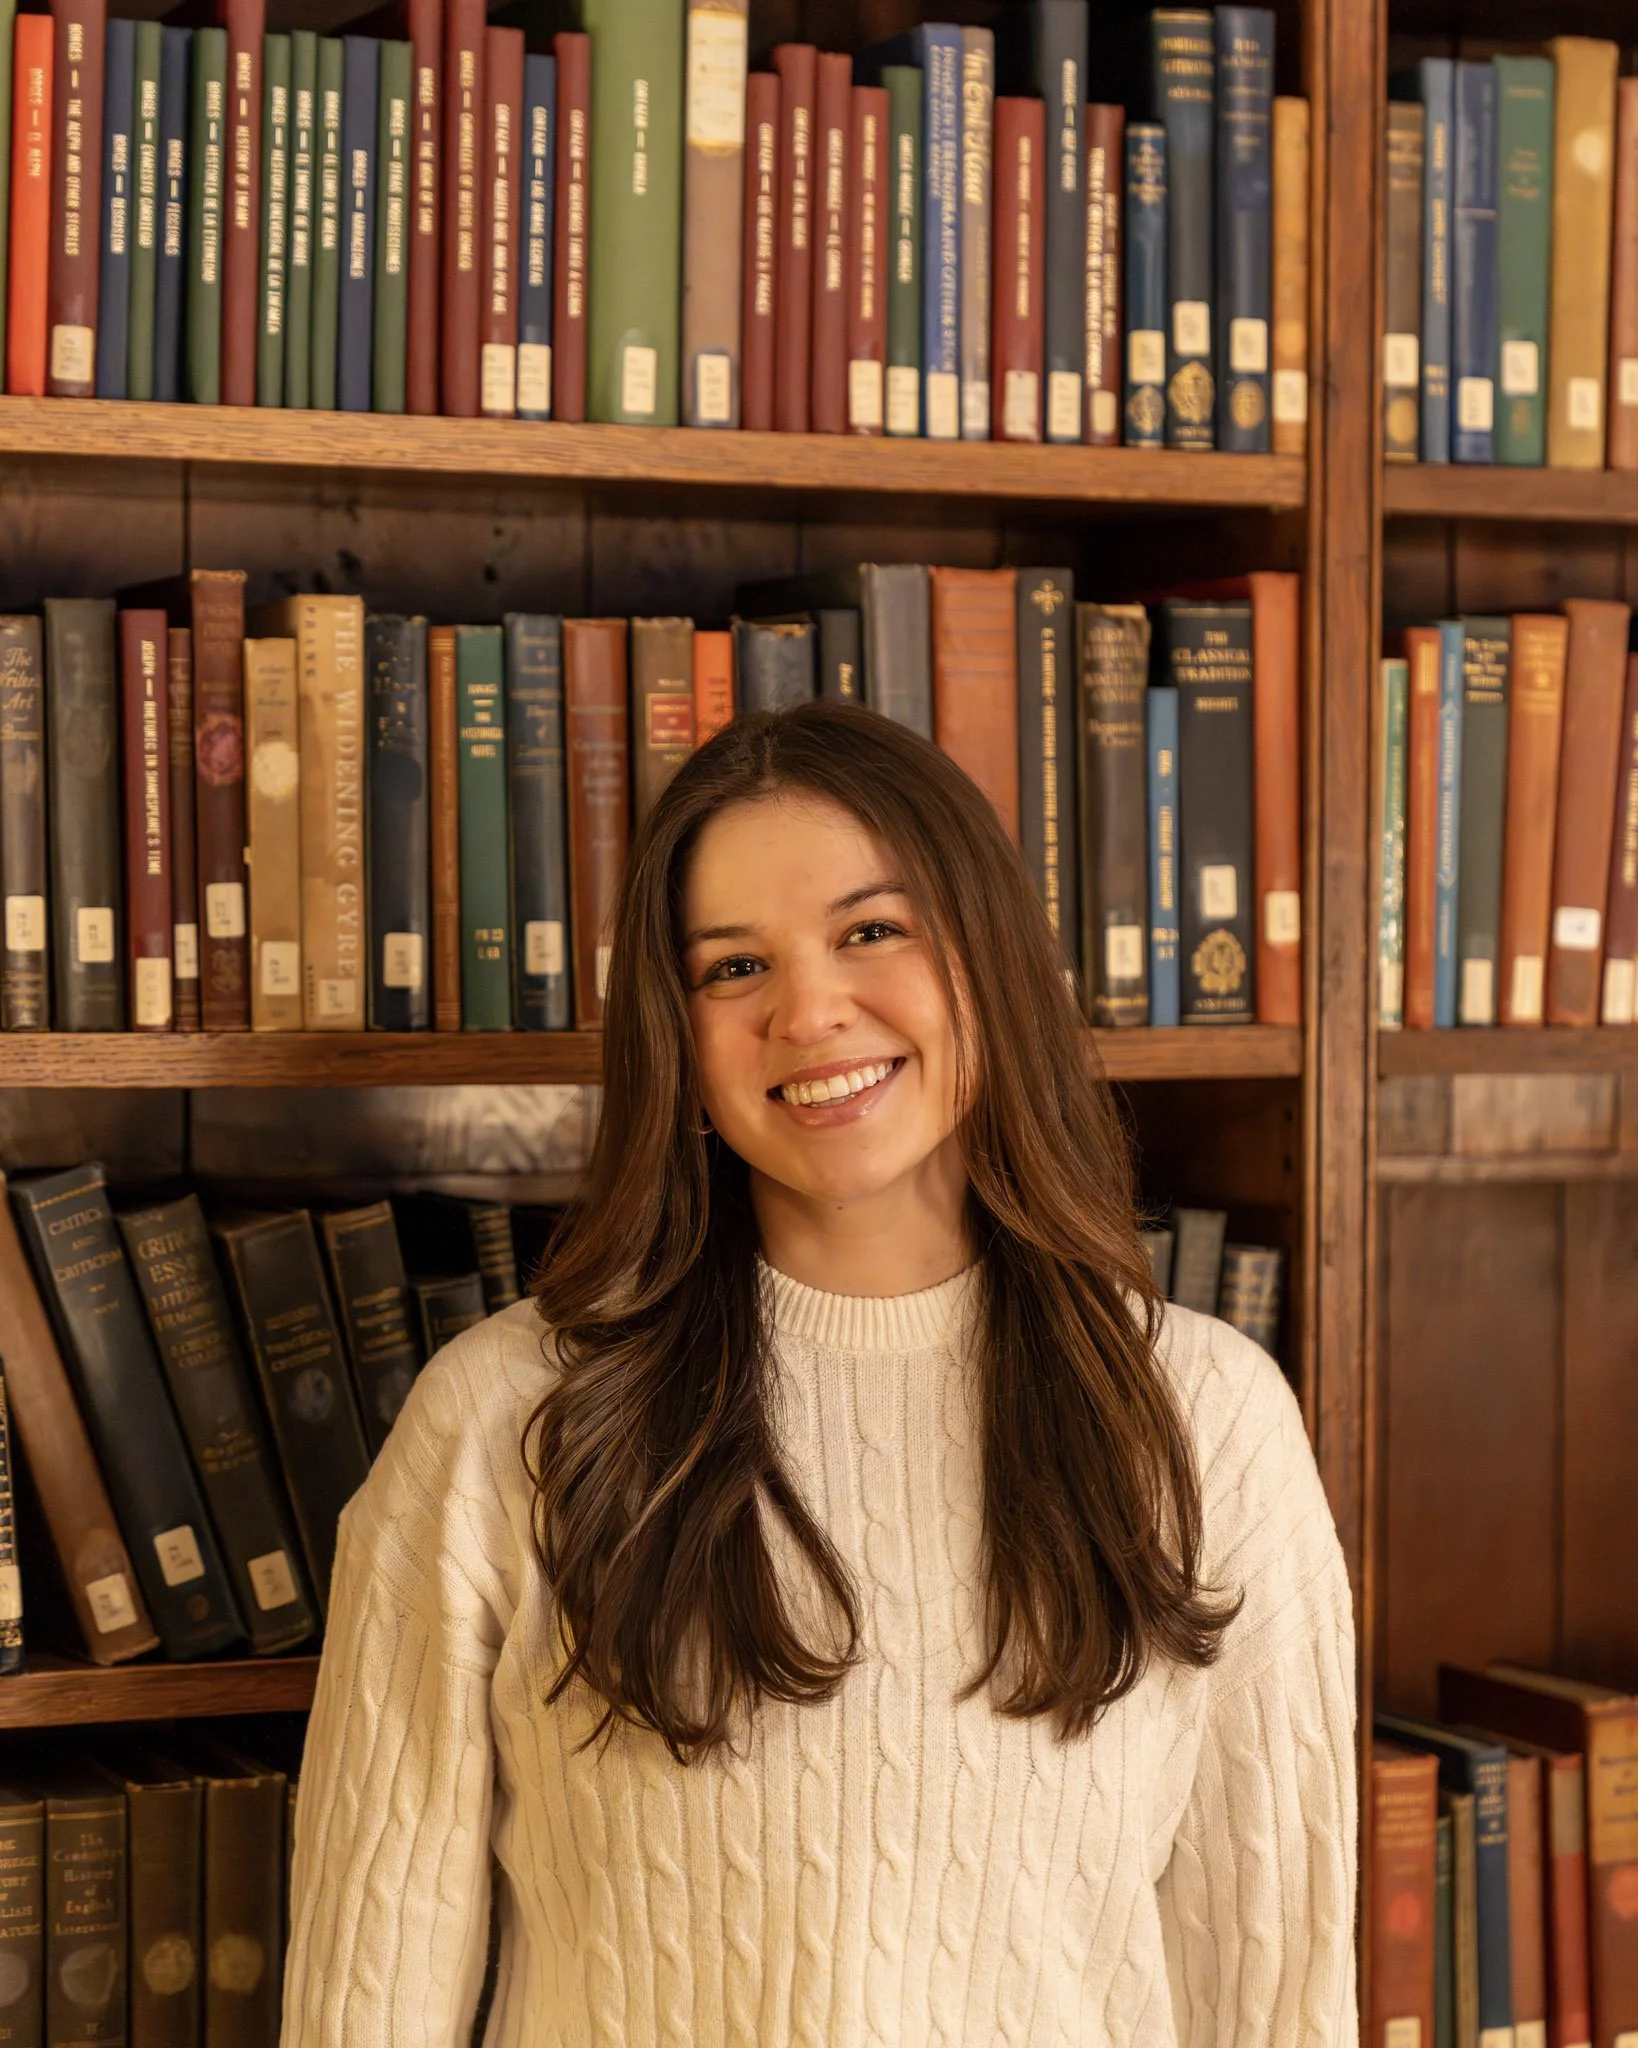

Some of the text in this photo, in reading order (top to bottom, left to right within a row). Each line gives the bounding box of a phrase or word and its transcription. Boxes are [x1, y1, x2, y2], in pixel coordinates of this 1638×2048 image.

[331, 604, 360, 978] THE WIDENING GYRE
